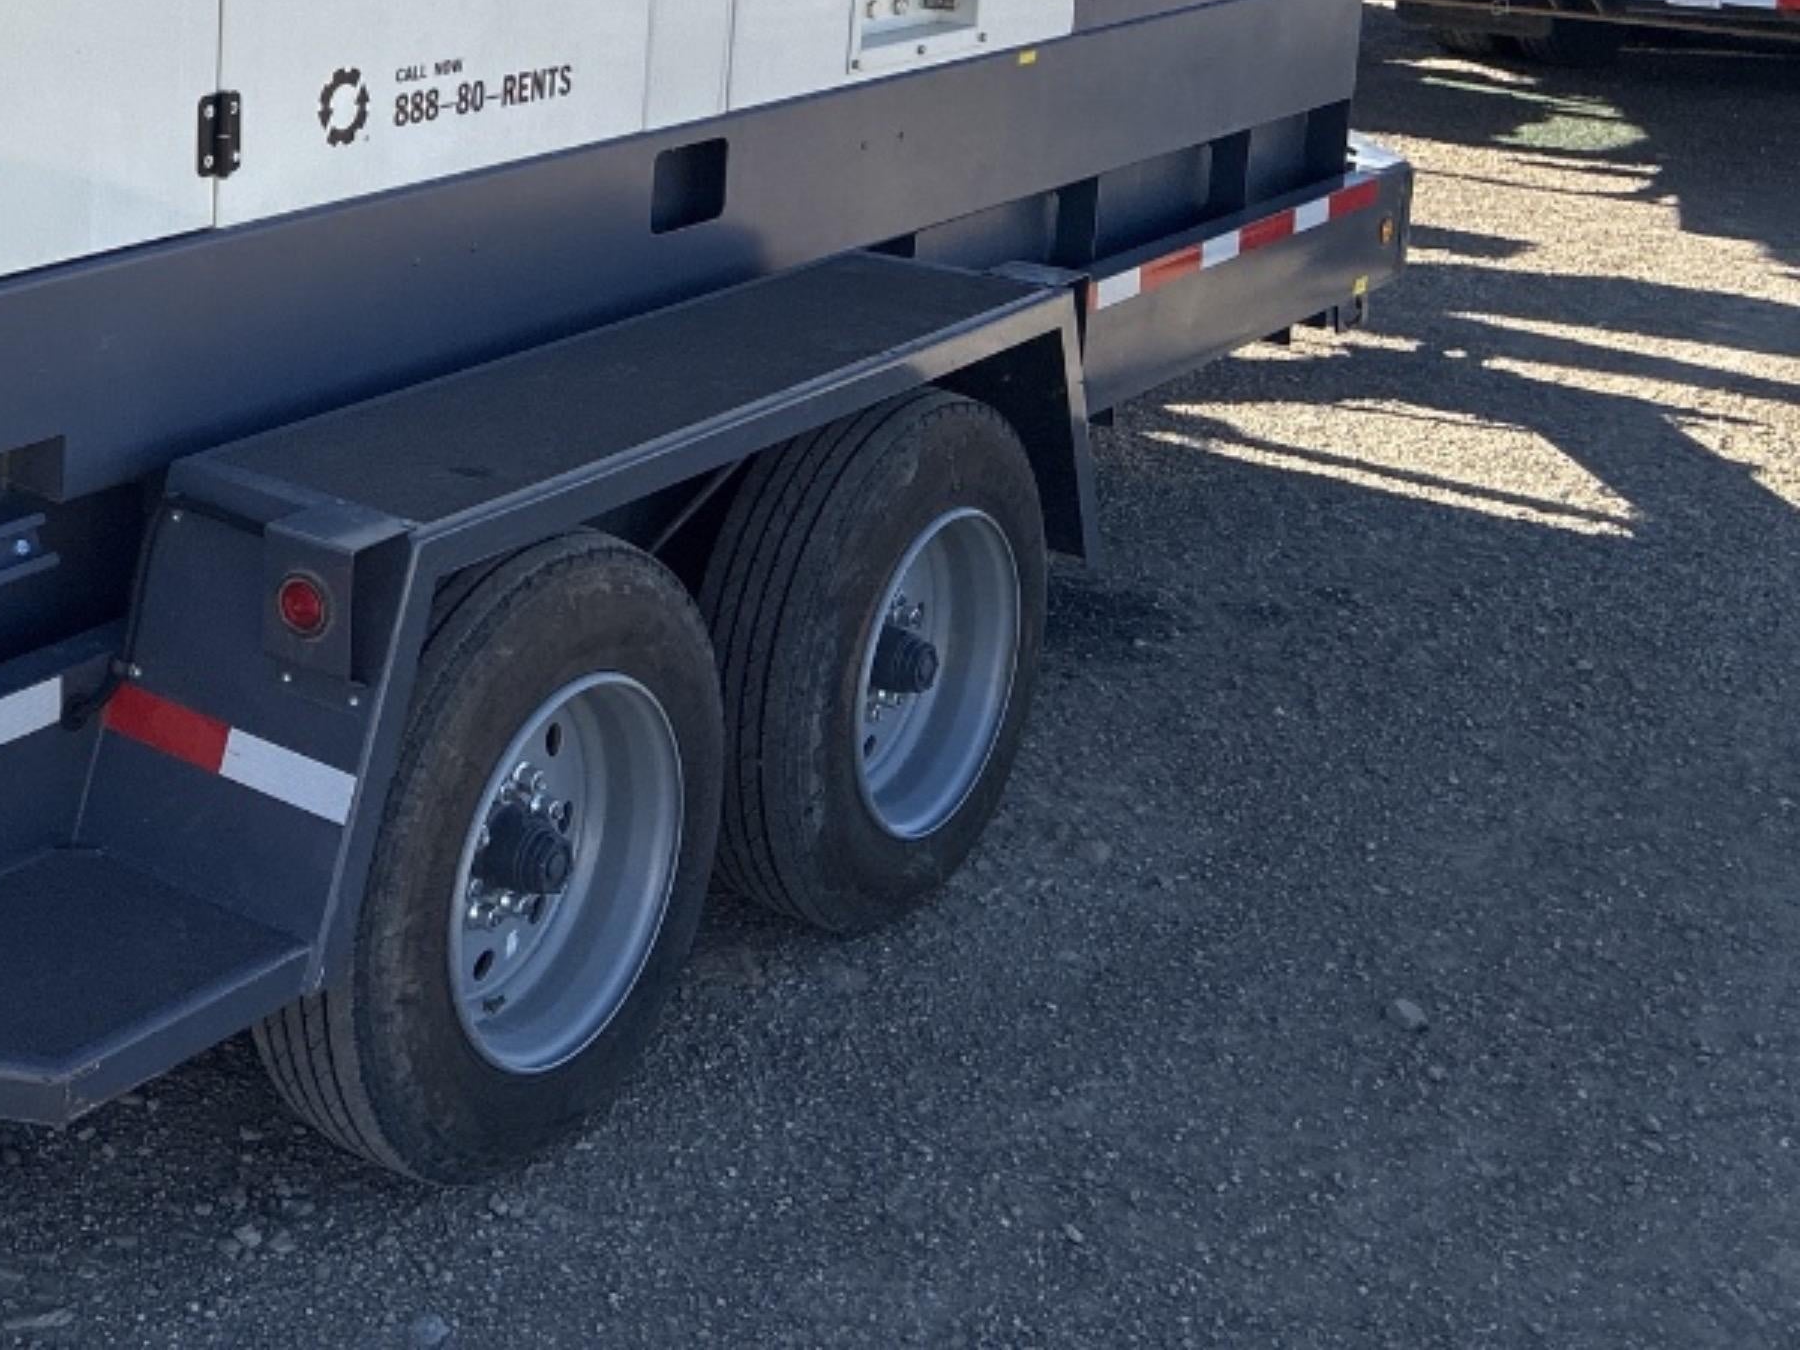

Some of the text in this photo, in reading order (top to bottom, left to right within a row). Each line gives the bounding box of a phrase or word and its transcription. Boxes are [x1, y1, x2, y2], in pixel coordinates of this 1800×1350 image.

[395, 57, 464, 83] CALL NOW
[393, 64, 573, 128] 888-80-RENTS
